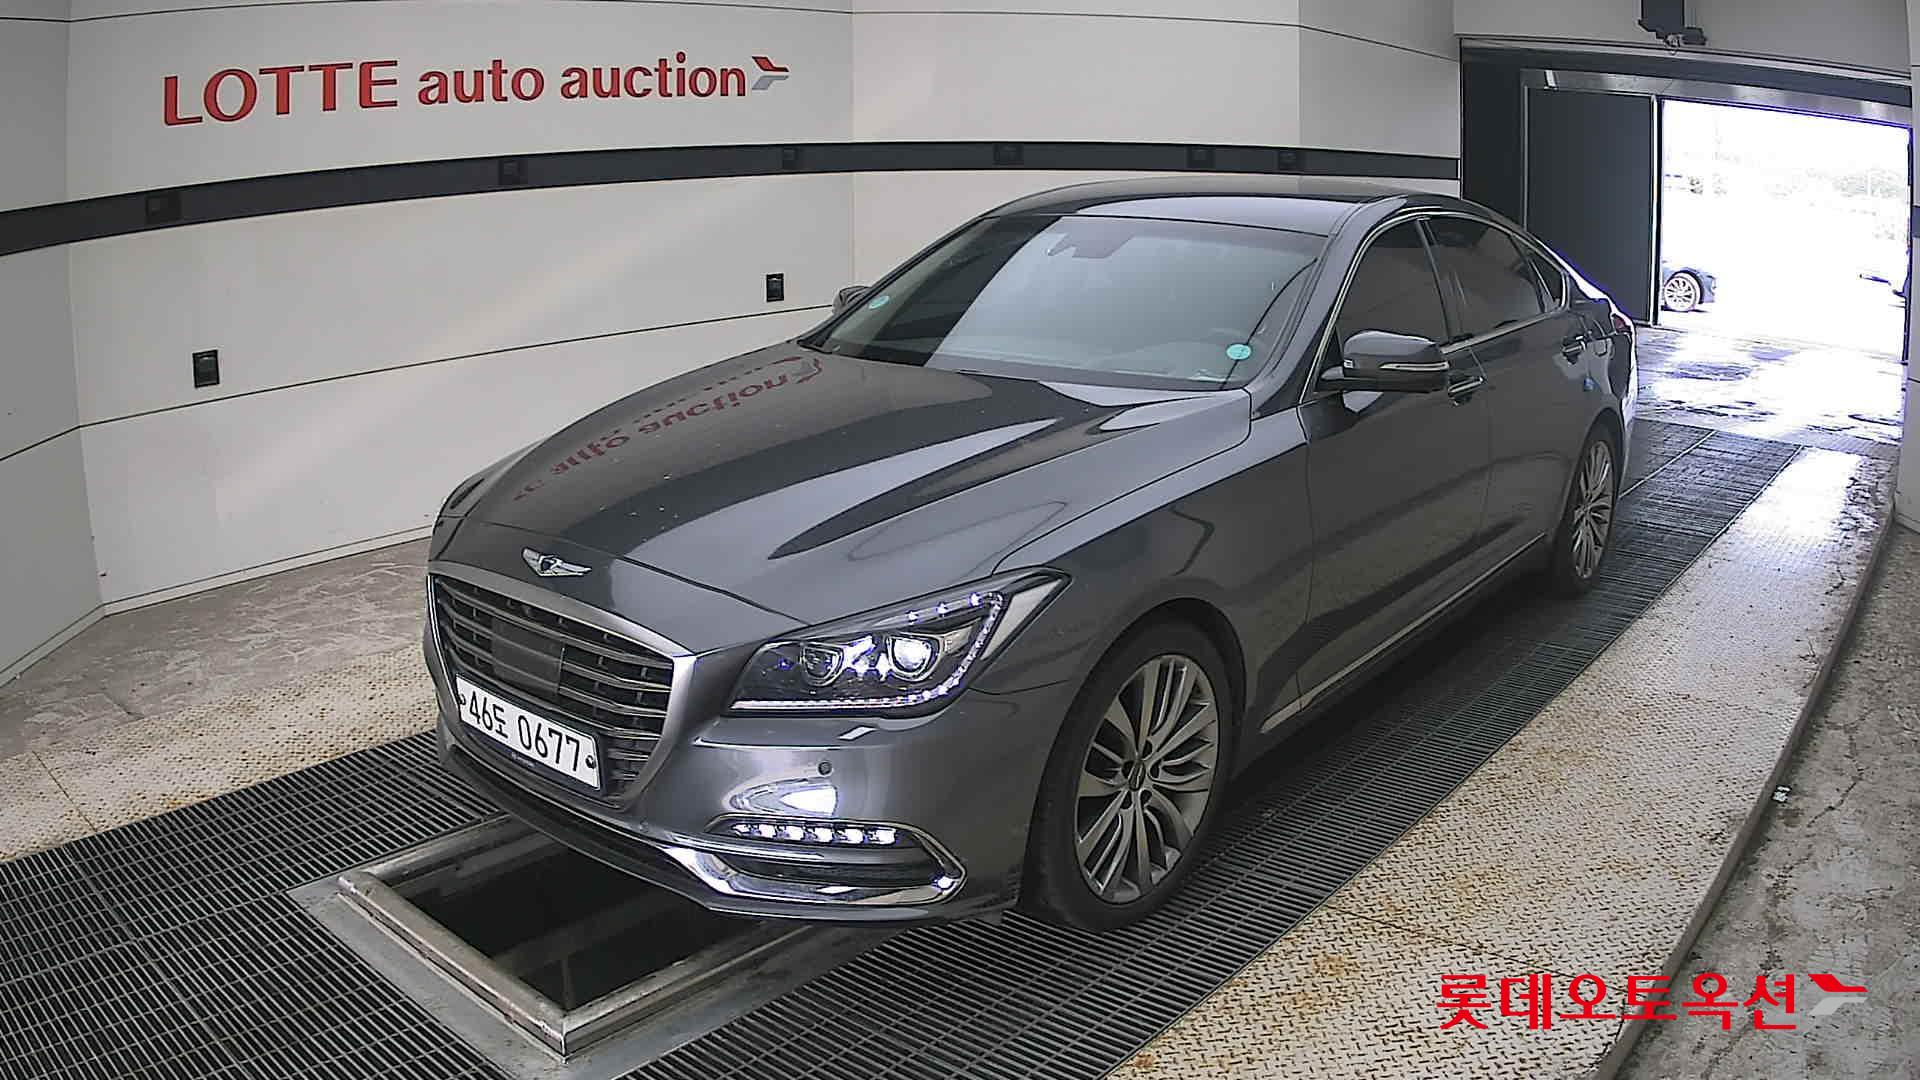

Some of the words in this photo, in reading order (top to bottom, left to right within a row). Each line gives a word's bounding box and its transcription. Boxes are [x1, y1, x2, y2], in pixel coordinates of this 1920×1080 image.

[162, 60, 399, 126] LOTTE
[417, 58, 544, 106] auto
[560, 51, 747, 99] auction
[469, 690, 509, 739] 46도
[517, 714, 580, 772] 0677
